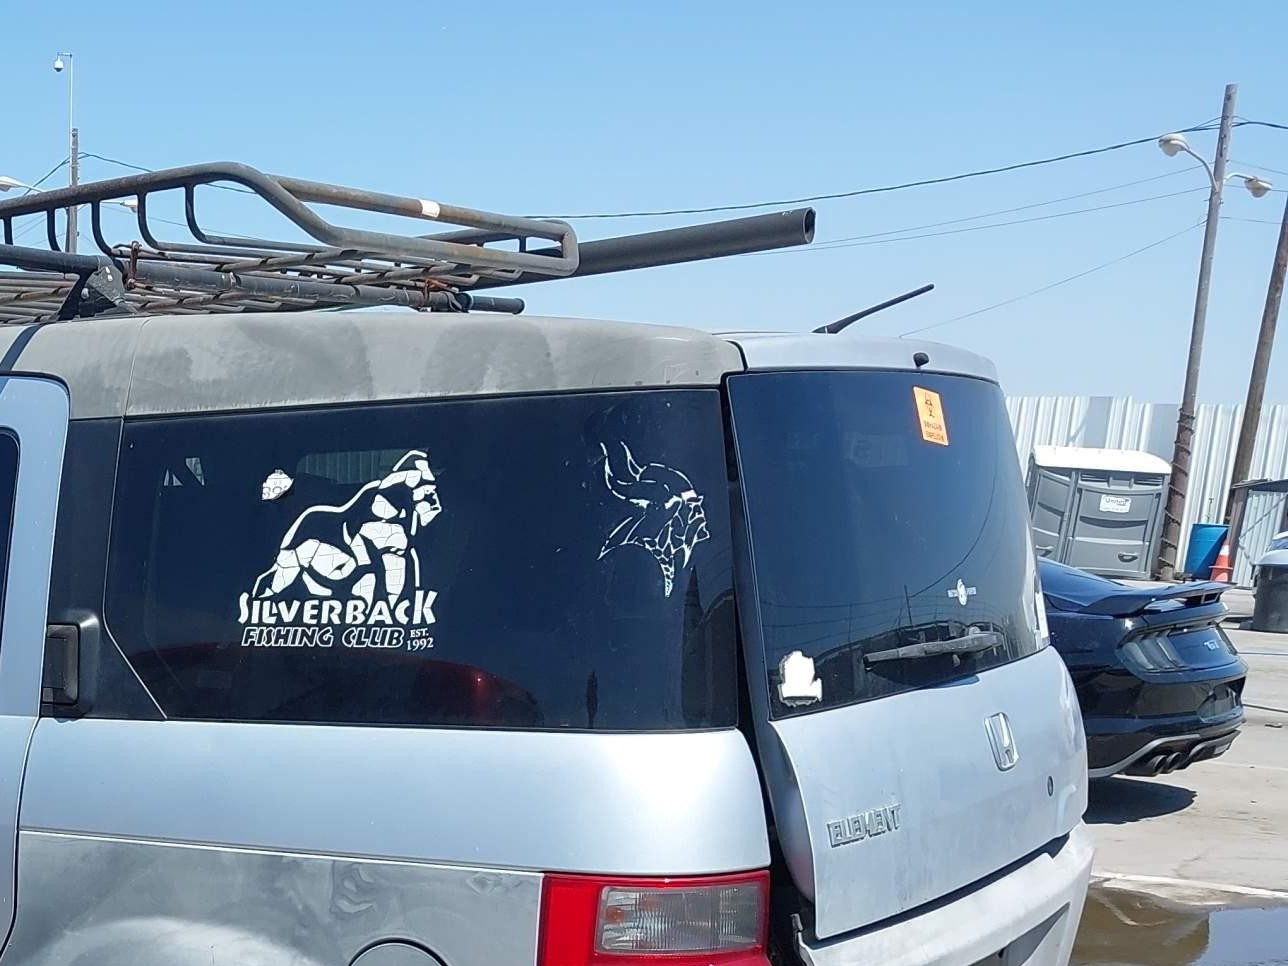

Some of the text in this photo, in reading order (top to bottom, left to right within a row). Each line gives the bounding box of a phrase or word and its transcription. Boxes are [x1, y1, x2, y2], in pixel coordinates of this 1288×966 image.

[238, 590, 438, 624] SILVERBACK
[241, 627, 405, 648] FISHING CLUB
[410, 628, 430, 638] EST.
[407, 637, 434, 651] 1992
[826, 804, 900, 849] ELEMENT
